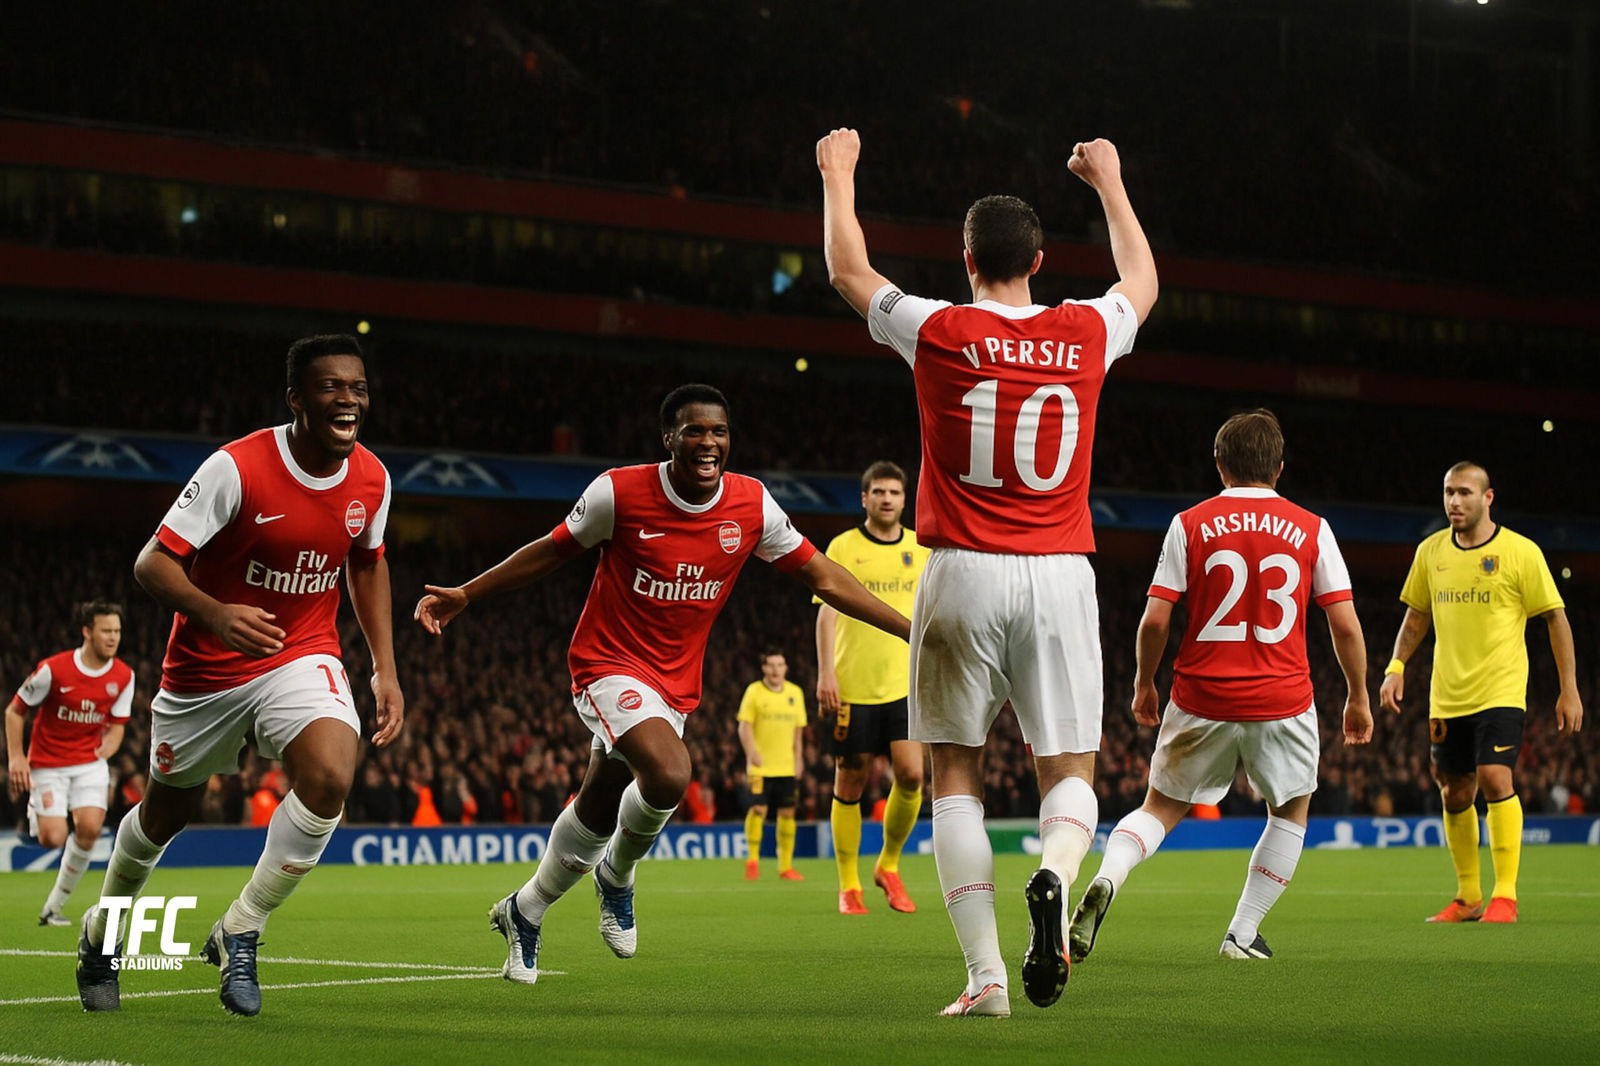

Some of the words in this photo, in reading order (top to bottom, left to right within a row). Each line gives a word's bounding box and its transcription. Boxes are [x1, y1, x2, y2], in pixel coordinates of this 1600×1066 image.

[962, 343, 980, 369] V
[984, 337, 1082, 370] PERSIE
[959, 379, 1079, 491] 10
[1200, 512, 1307, 550] ARSHAVIN
[296, 550, 328, 572] Fly
[676, 563, 704, 579] Fly
[1196, 549, 1300, 644] 23
[352, 833, 547, 866] CHAMPIO
[654, 832, 748, 860] AGUE
